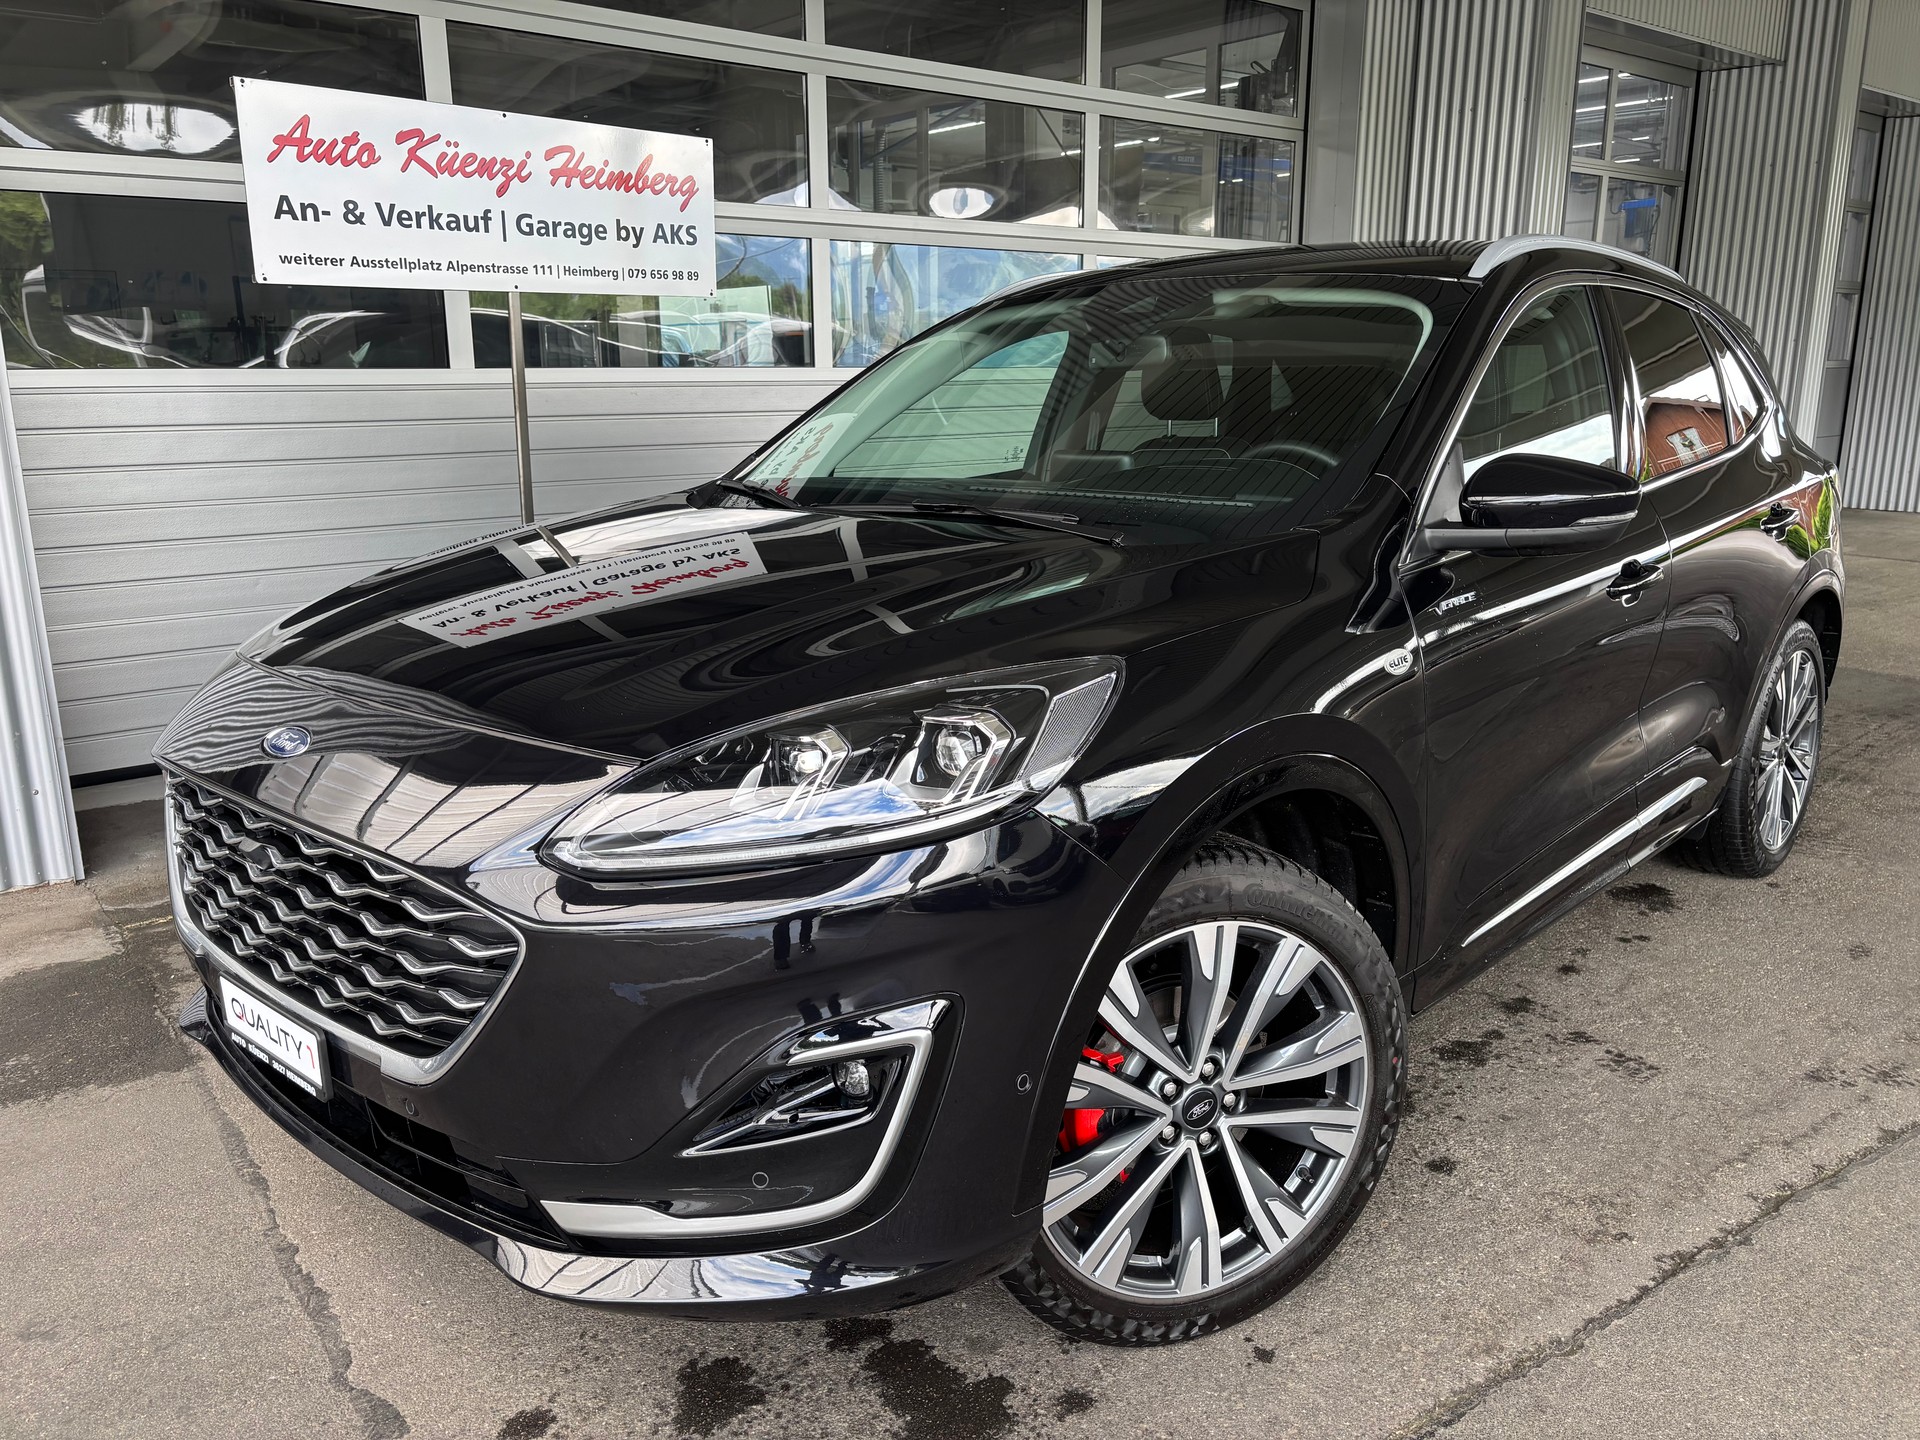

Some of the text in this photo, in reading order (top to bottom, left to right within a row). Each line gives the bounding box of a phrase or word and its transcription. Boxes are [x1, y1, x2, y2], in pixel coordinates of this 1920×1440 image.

[267, 114, 699, 212] Auto Küenzi Heimberg
[274, 194, 331, 222] An-
[342, 199, 366, 226] &
[374, 201, 493, 234] Verkauf
[515, 213, 608, 246] Garage
[615, 218, 645, 249] by
[652, 223, 698, 246] AKS
[278, 252, 345, 267] weiterer
[350, 255, 443, 273] Ausstellplatz
[446, 259, 529, 276] Alpenstrasse
[532, 264, 553, 276] 111
[563, 265, 619, 280] Heimberg
[627, 268, 647, 279] 079
[650, 269, 669, 280] 656
[671, 270, 684, 281] 98
[686, 271, 699, 282] 89
[1389, 655, 1409, 669] ELITE
[271, 730, 302, 752] Ford
[231, 1032, 247, 1048] AUTO
